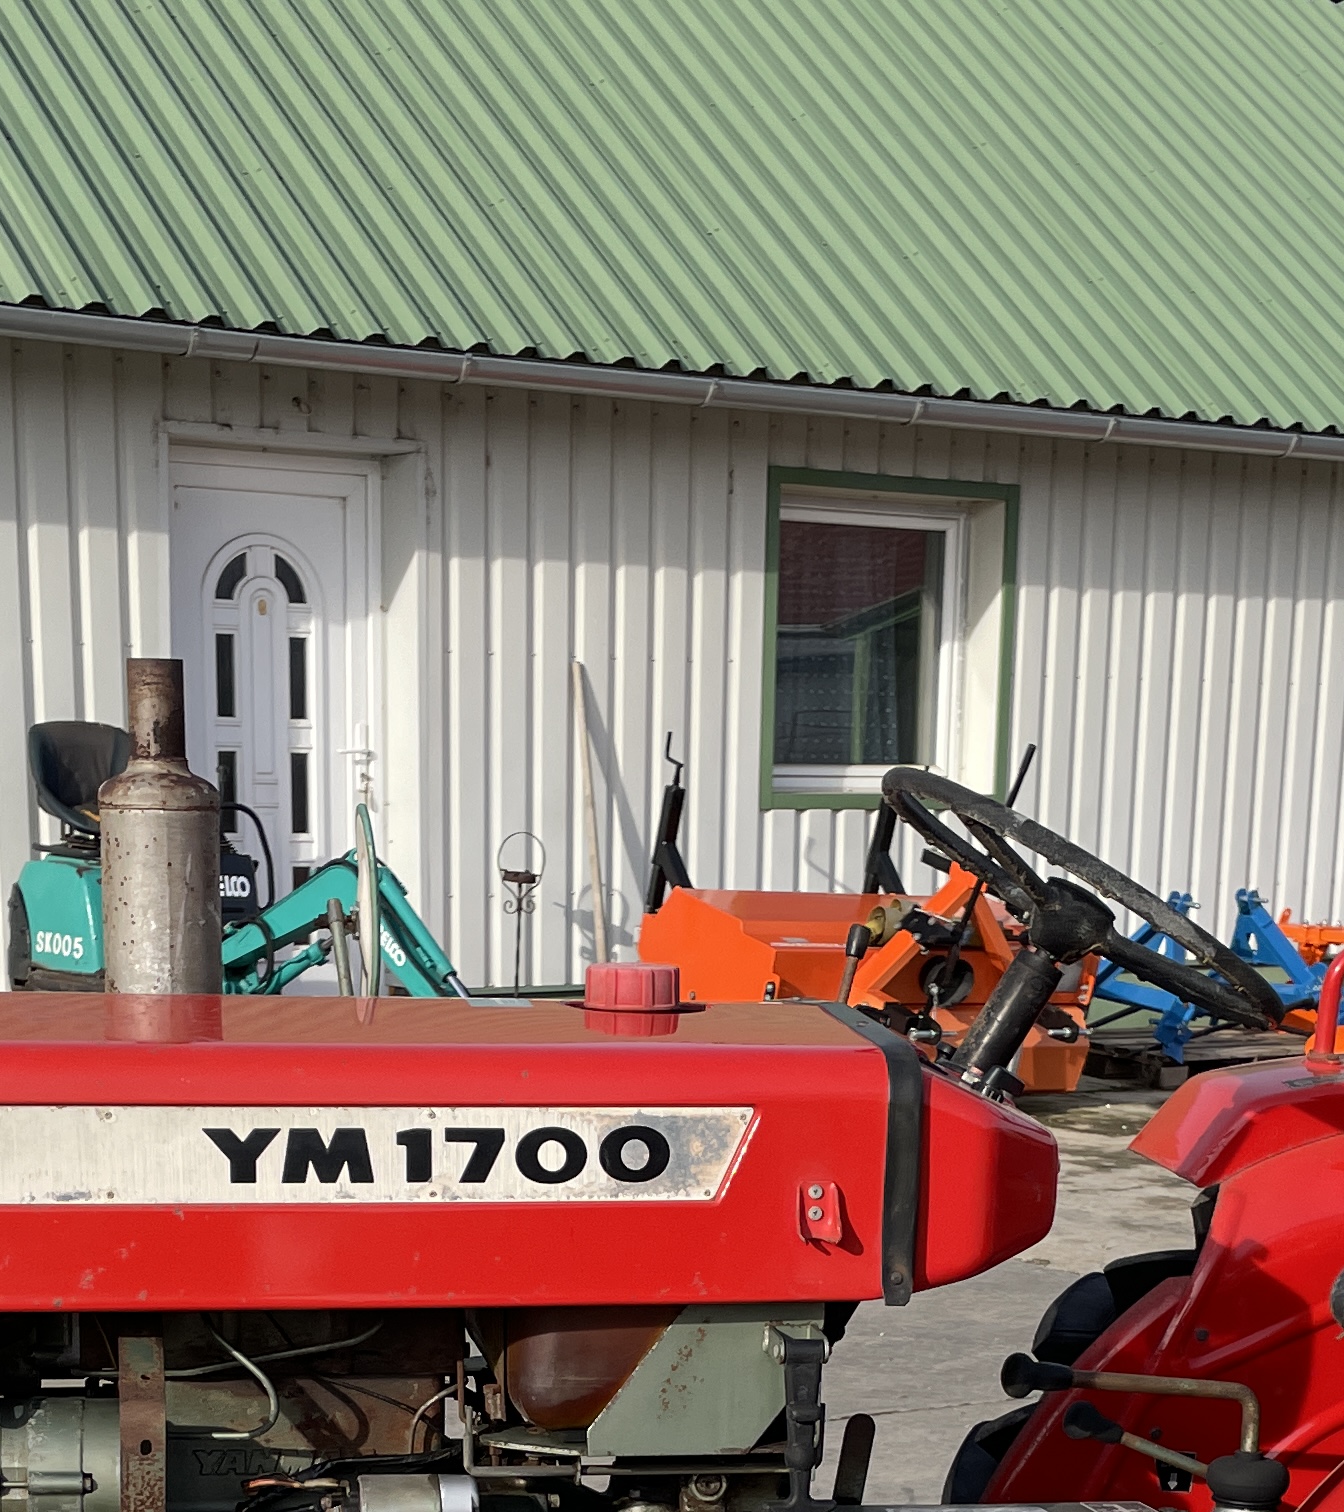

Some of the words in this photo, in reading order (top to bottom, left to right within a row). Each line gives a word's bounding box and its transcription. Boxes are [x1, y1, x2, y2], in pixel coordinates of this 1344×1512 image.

[219, 875, 250, 897] ELCO
[35, 930, 84, 959] SK005
[380, 924, 406, 967] ELCO
